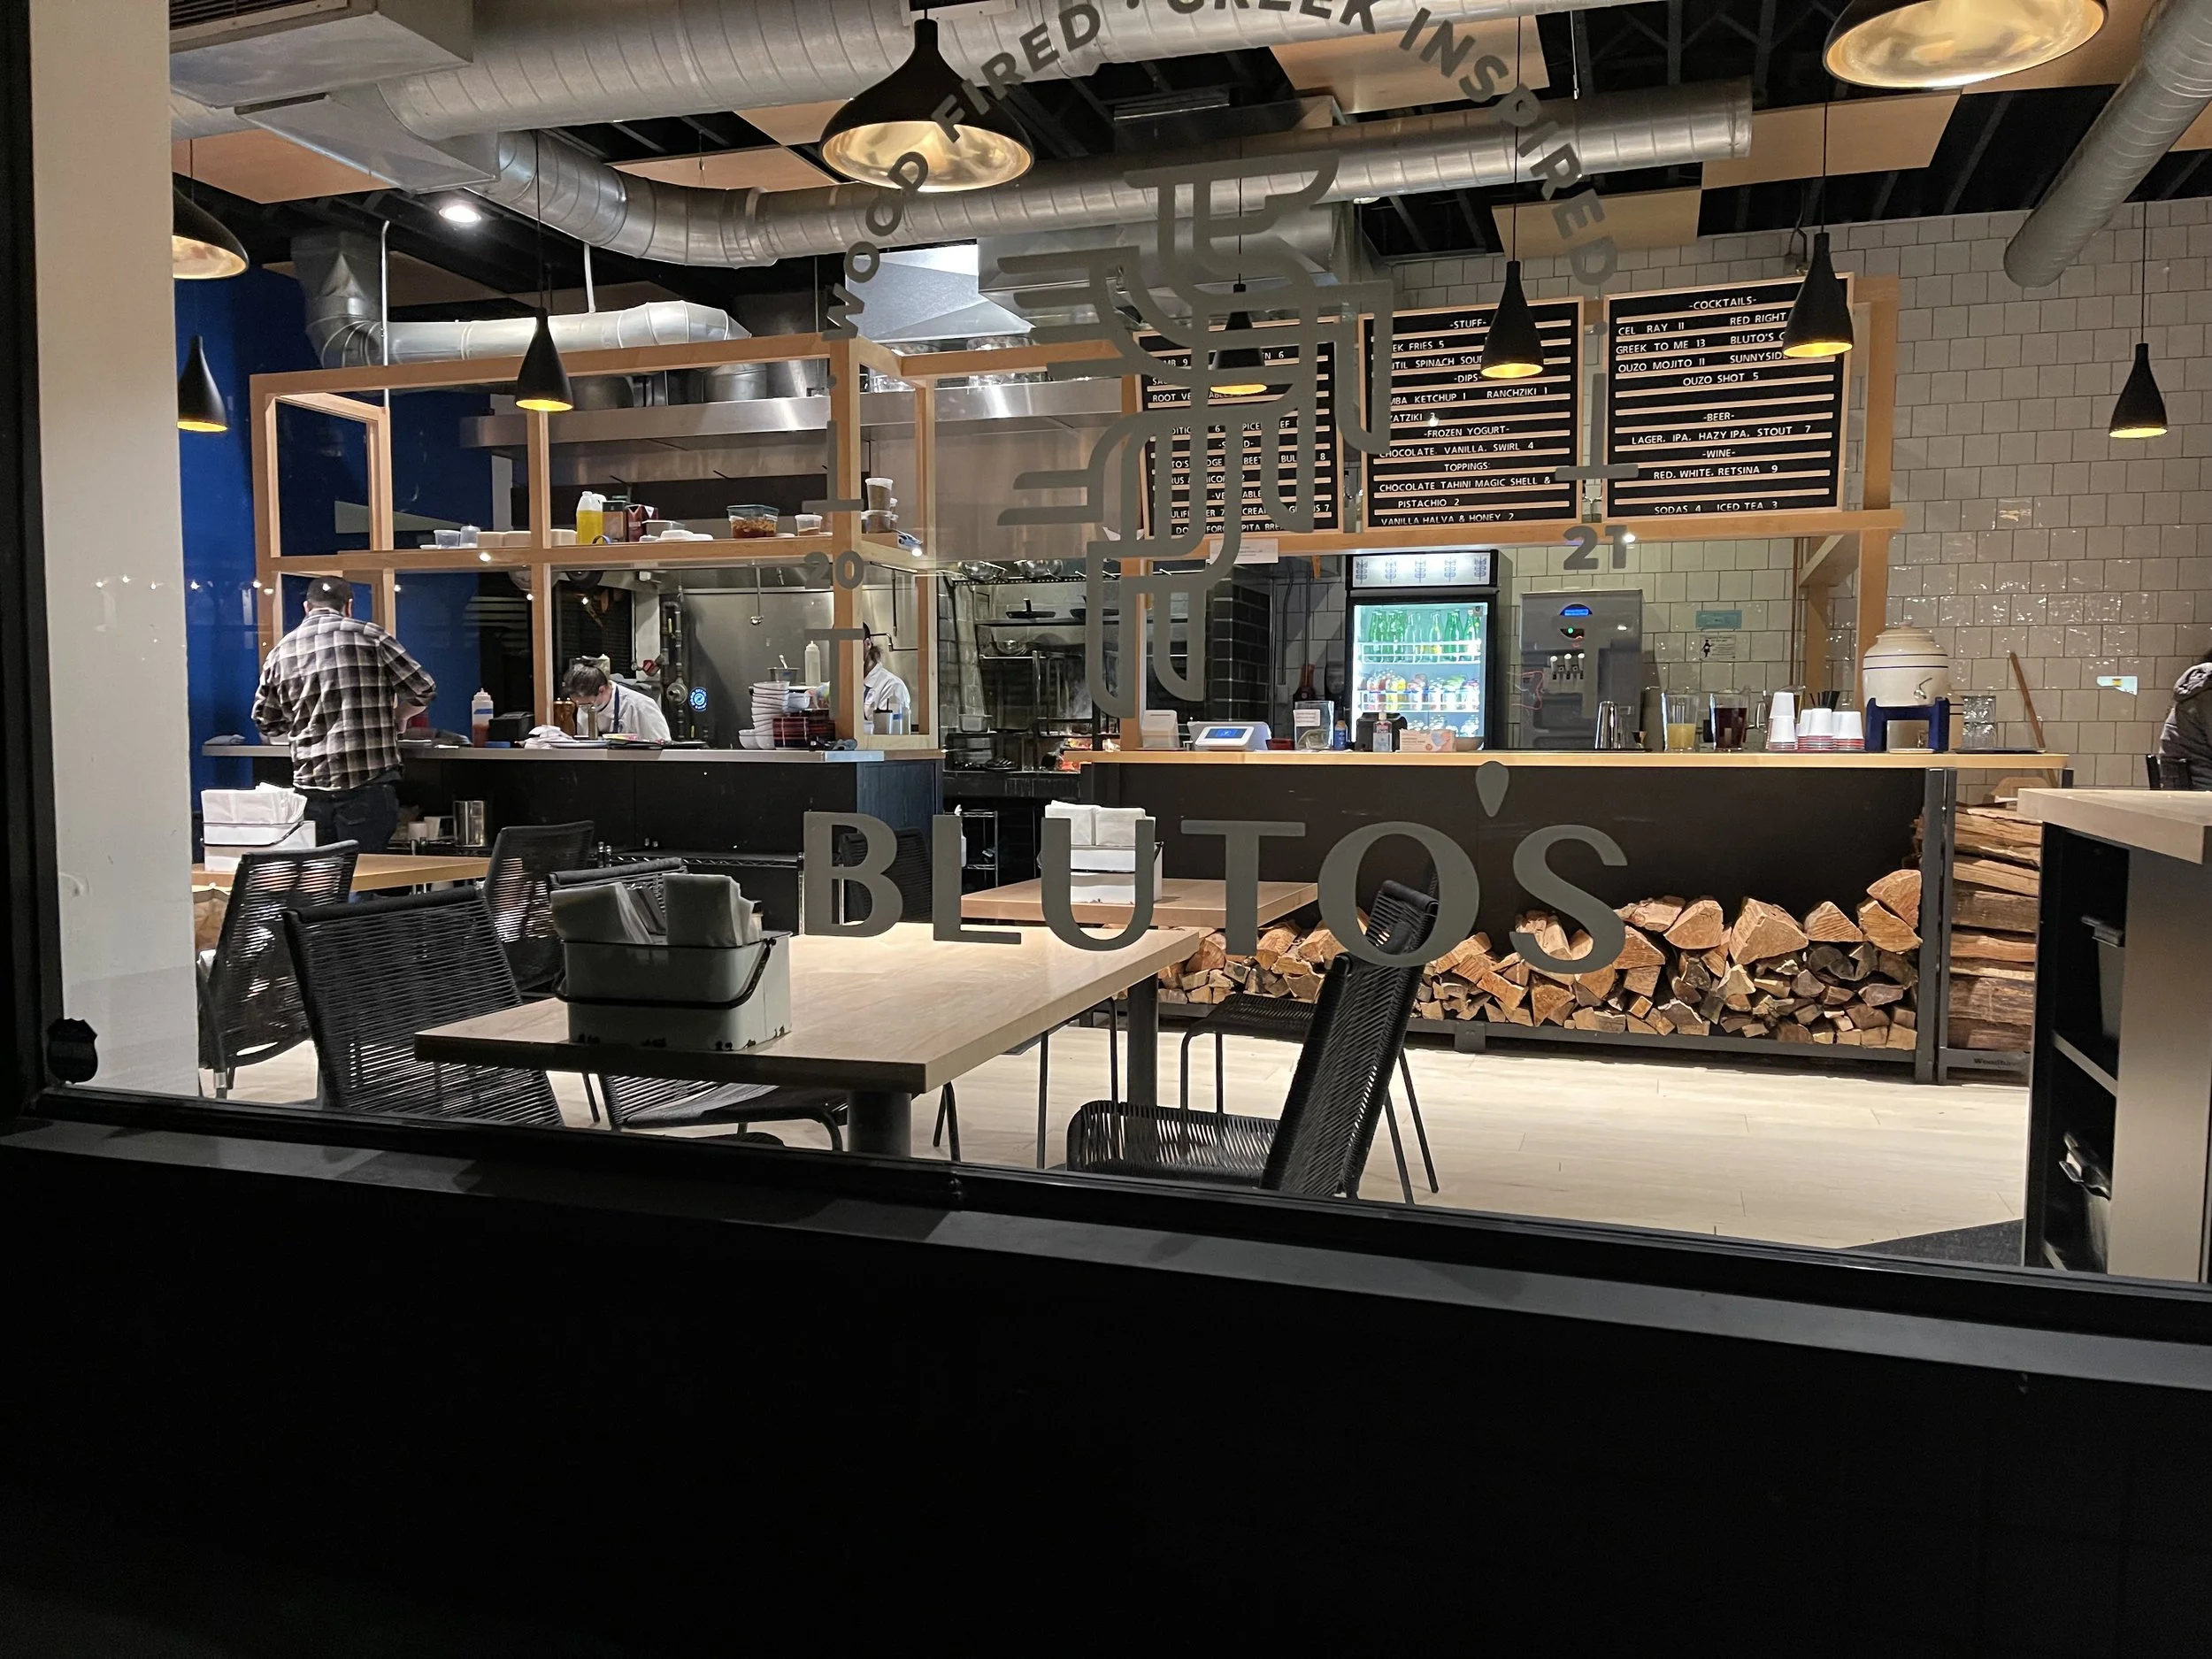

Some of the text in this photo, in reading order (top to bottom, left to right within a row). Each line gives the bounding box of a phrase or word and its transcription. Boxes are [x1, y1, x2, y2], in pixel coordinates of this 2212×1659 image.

[821, 4, 1618, 342] WOOD FIRED INSPIRED
[1688, 296, 1757, 310] -COCKTAILS-
[1449, 319, 1487, 329] -STUFF-
[1729, 312, 1786, 326] RED RIGHT
[1617, 326, 1636, 336] CEL
[1646, 323, 1669, 334] RAY
[1730, 333, 1775, 345] BLUTO'S
[1409, 341, 1433, 351] FRIES
[1438, 340, 1445, 349] 5
[1616, 339, 1706, 355] GREEK TO ME 13
[1278, 350, 1285, 359] 6
[1415, 357, 1455, 368] SPINACH
[1617, 363, 1647, 373] OUZO
[1652, 359, 1693, 371] MOJITO
[1454, 373, 1482, 383] -DIPS-
[1682, 372, 1759, 387] OUZO SHOT 5
[1152, 393, 1176, 403] ROOT
[1414, 394, 1457, 403] KETCHUP
[1486, 388, 1538, 399] RANCHZIKI
[1391, 413, 1423, 423] ATZIKI
[1702, 411, 1735, 422] -BEER-
[1698, 431, 1726, 441] HAZY
[1756, 426, 1793, 438] STOUT
[1493, 442, 1520, 452] SWIRL
[1527, 441, 1534, 449] 4
[1319, 452, 1326, 461] 8
[1701, 449, 1736, 458] -WINE-
[1717, 465, 1760, 476] RETSINA
[1771, 465, 1778, 473] 9
[1379, 475, 1551, 493] CHOCOLATE TAHINI MAGIC SHELL &
[1324, 503, 1330, 512] 7
[1397, 497, 1460, 508] PISTACHIO 2
[1655, 500, 1778, 515] SODAS 4 ICED TEA 3
[1380, 512, 1515, 526] VANILLA HALVA & HONEY 2
[1563, 525, 1630, 571] 21
[803, 550, 865, 591] 20
[803, 760, 1628, 975] BLUTO'S
